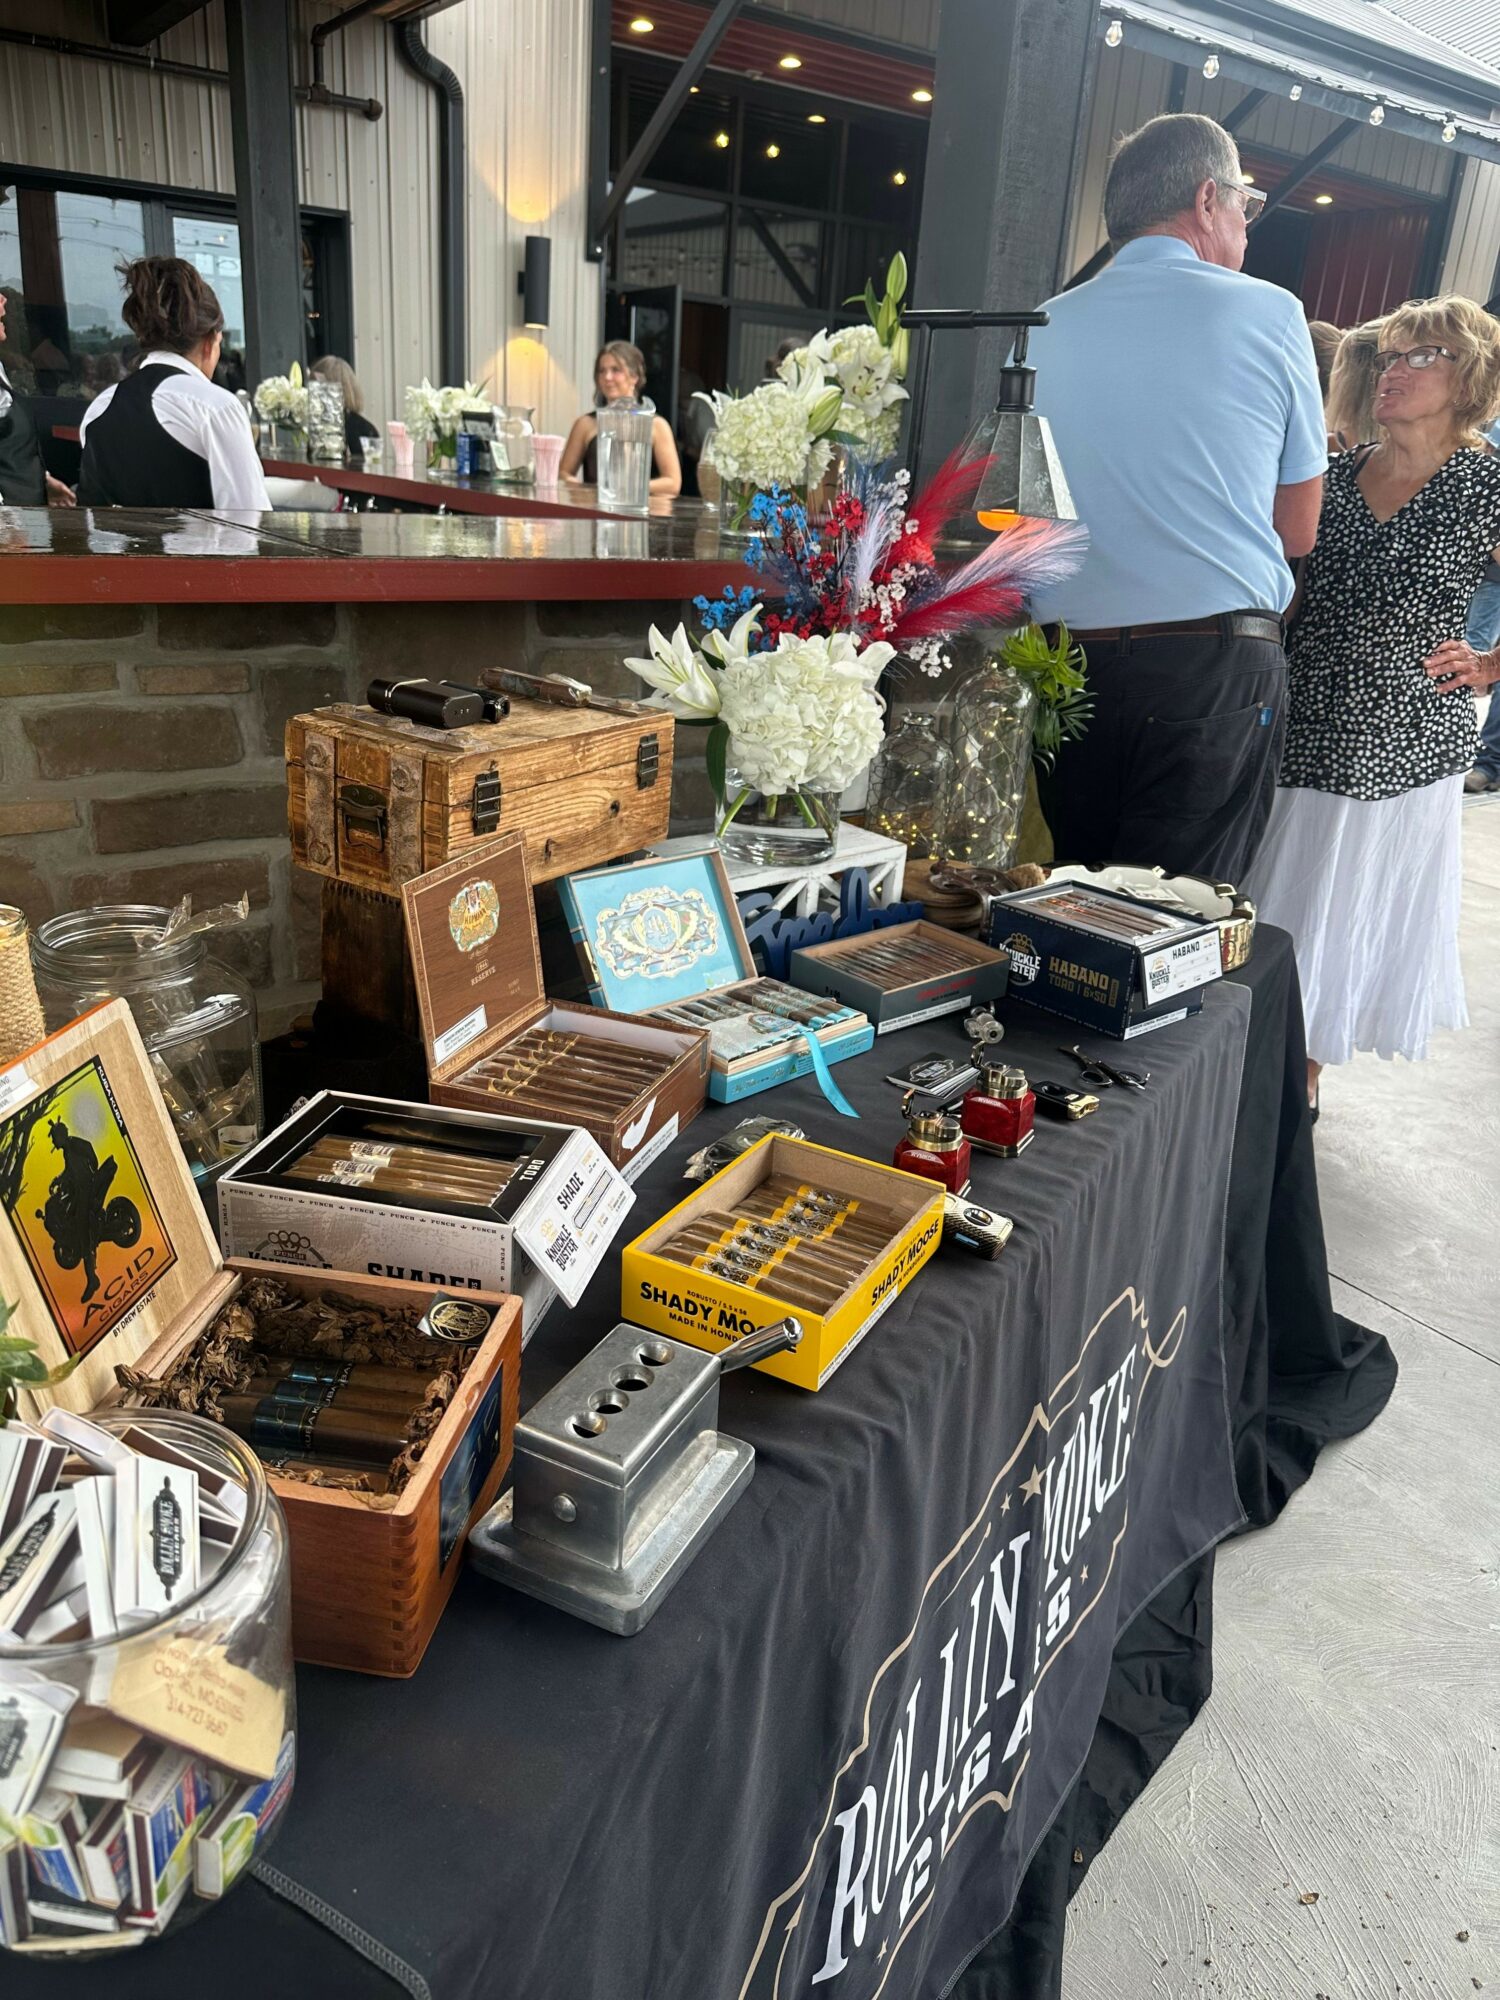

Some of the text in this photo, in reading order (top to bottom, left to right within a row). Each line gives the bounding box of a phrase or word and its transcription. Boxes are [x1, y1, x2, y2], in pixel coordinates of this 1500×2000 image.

[999, 943, 1042, 970] UCKLE
[1172, 941, 1200, 960] HABANO
[1009, 960, 1040, 982] STER
[1049, 956, 1110, 991] HABANO
[1049, 973, 1075, 993] TORO
[1149, 965, 1171, 980] KNUCKLE
[1152, 975, 1170, 990] BUSTER
[97, 1066, 124, 1128] KUBA KUBA
[519, 1159, 545, 1182] TORO
[557, 1171, 585, 1211] SHADE
[269, 1194, 294, 1202] PUNCH
[309, 1200, 334, 1208] PUNCH
[349, 1207, 374, 1215] PUNCH
[431, 1219, 456, 1227] PUNCH
[471, 1226, 497, 1234] PUNCH
[545, 1224, 572, 1263] KNUCKLE
[556, 1238, 579, 1272] BUSTER
[871, 1256, 906, 1307] SHADY
[906, 1217, 940, 1265] MOOSE
[83, 1247, 155, 1328] ACID
[100, 1271, 149, 1322] CIGARS
[640, 1281, 715, 1322] SHADY
[686, 1290, 717, 1305] ROBUSTO
[112, 1290, 157, 1338] BY DREW ESTATE
[668, 1312, 740, 1343] MADE IN HOND
[812, 1531, 1031, 1985] ROLLIN
[1043, 1343, 1137, 1592] MOKE
[900, 1576, 1072, 1928] CIGAS
